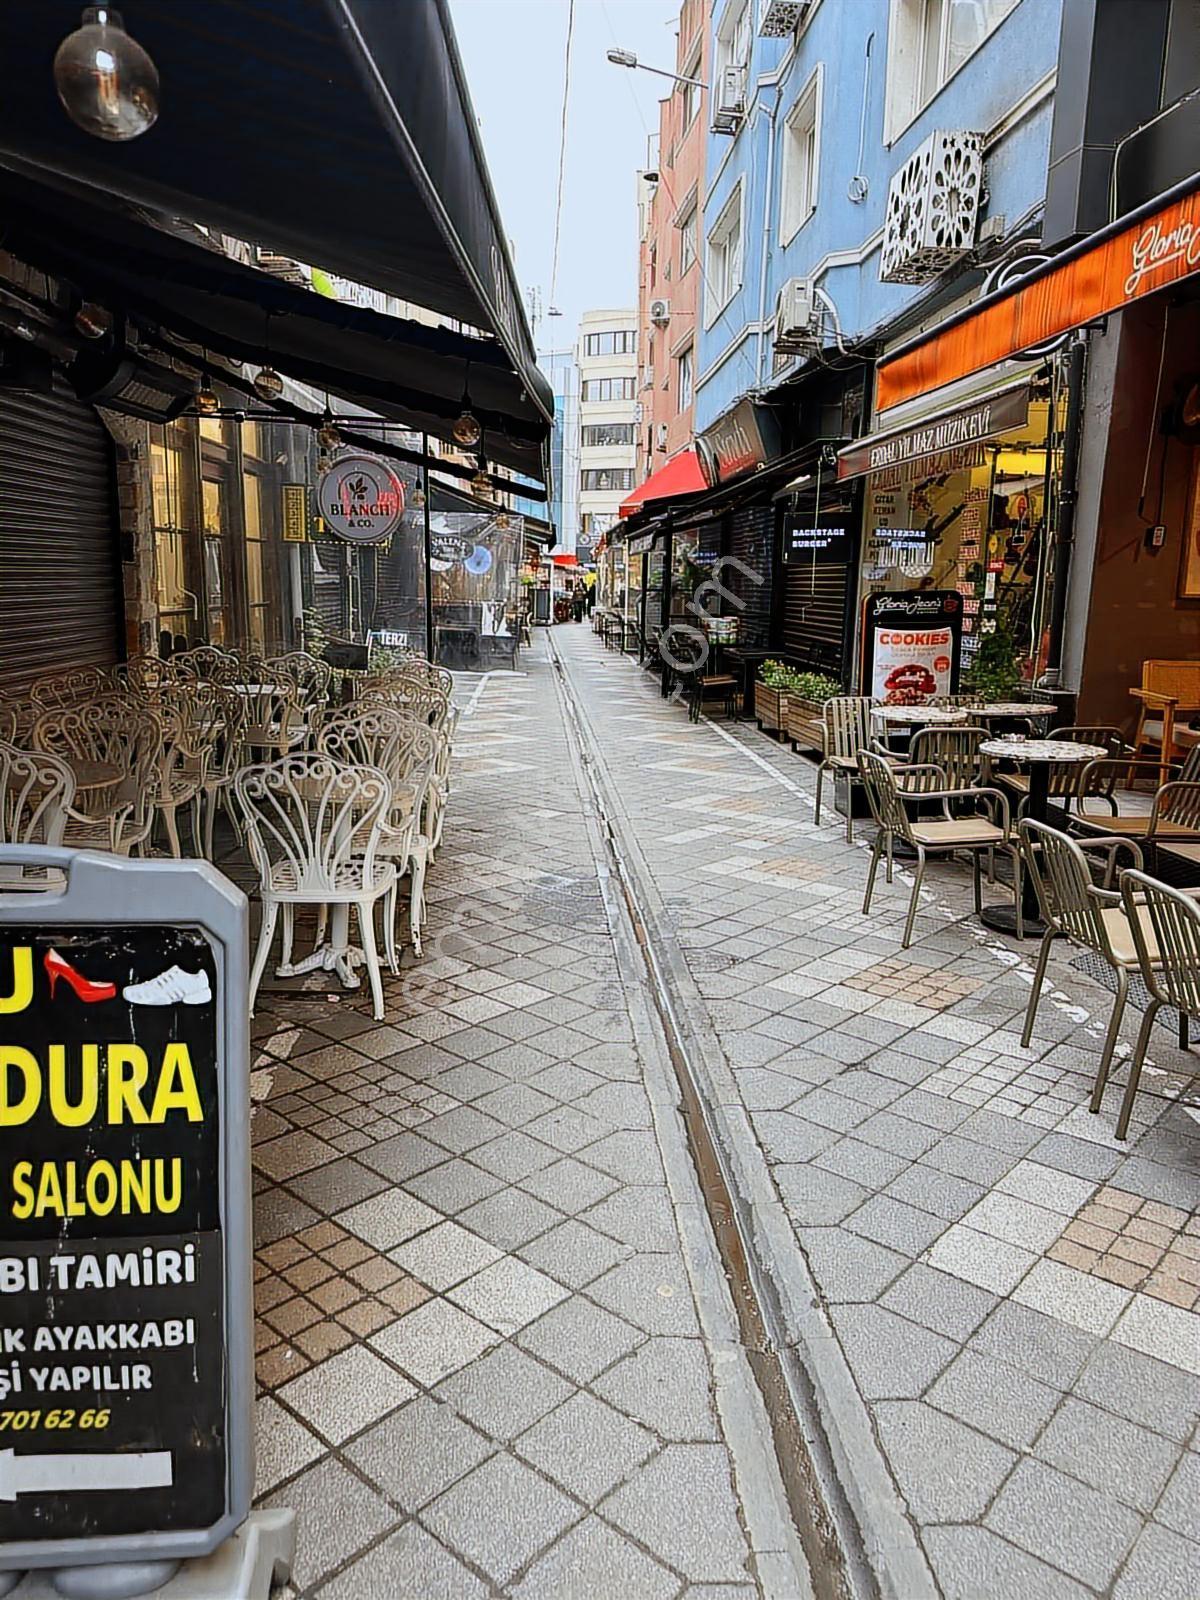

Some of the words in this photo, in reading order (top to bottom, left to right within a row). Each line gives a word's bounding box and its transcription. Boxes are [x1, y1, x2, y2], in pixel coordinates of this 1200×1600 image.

[1124, 219, 1194, 295] Gloria
[330, 504, 390, 516] BLANCH
[792, 528, 845, 537] BACKSTAGE
[880, 633, 950, 646] COOKIES
[12, 1157, 182, 1219] SALONU
[50, 1243, 196, 1291] TAMİRİ
[34, 1319, 195, 1352] AYAKKABI
[29, 1364, 152, 1391] YAPILIR
[44, 1409, 73, 1429] 62
[78, 1408, 111, 1429] 66
